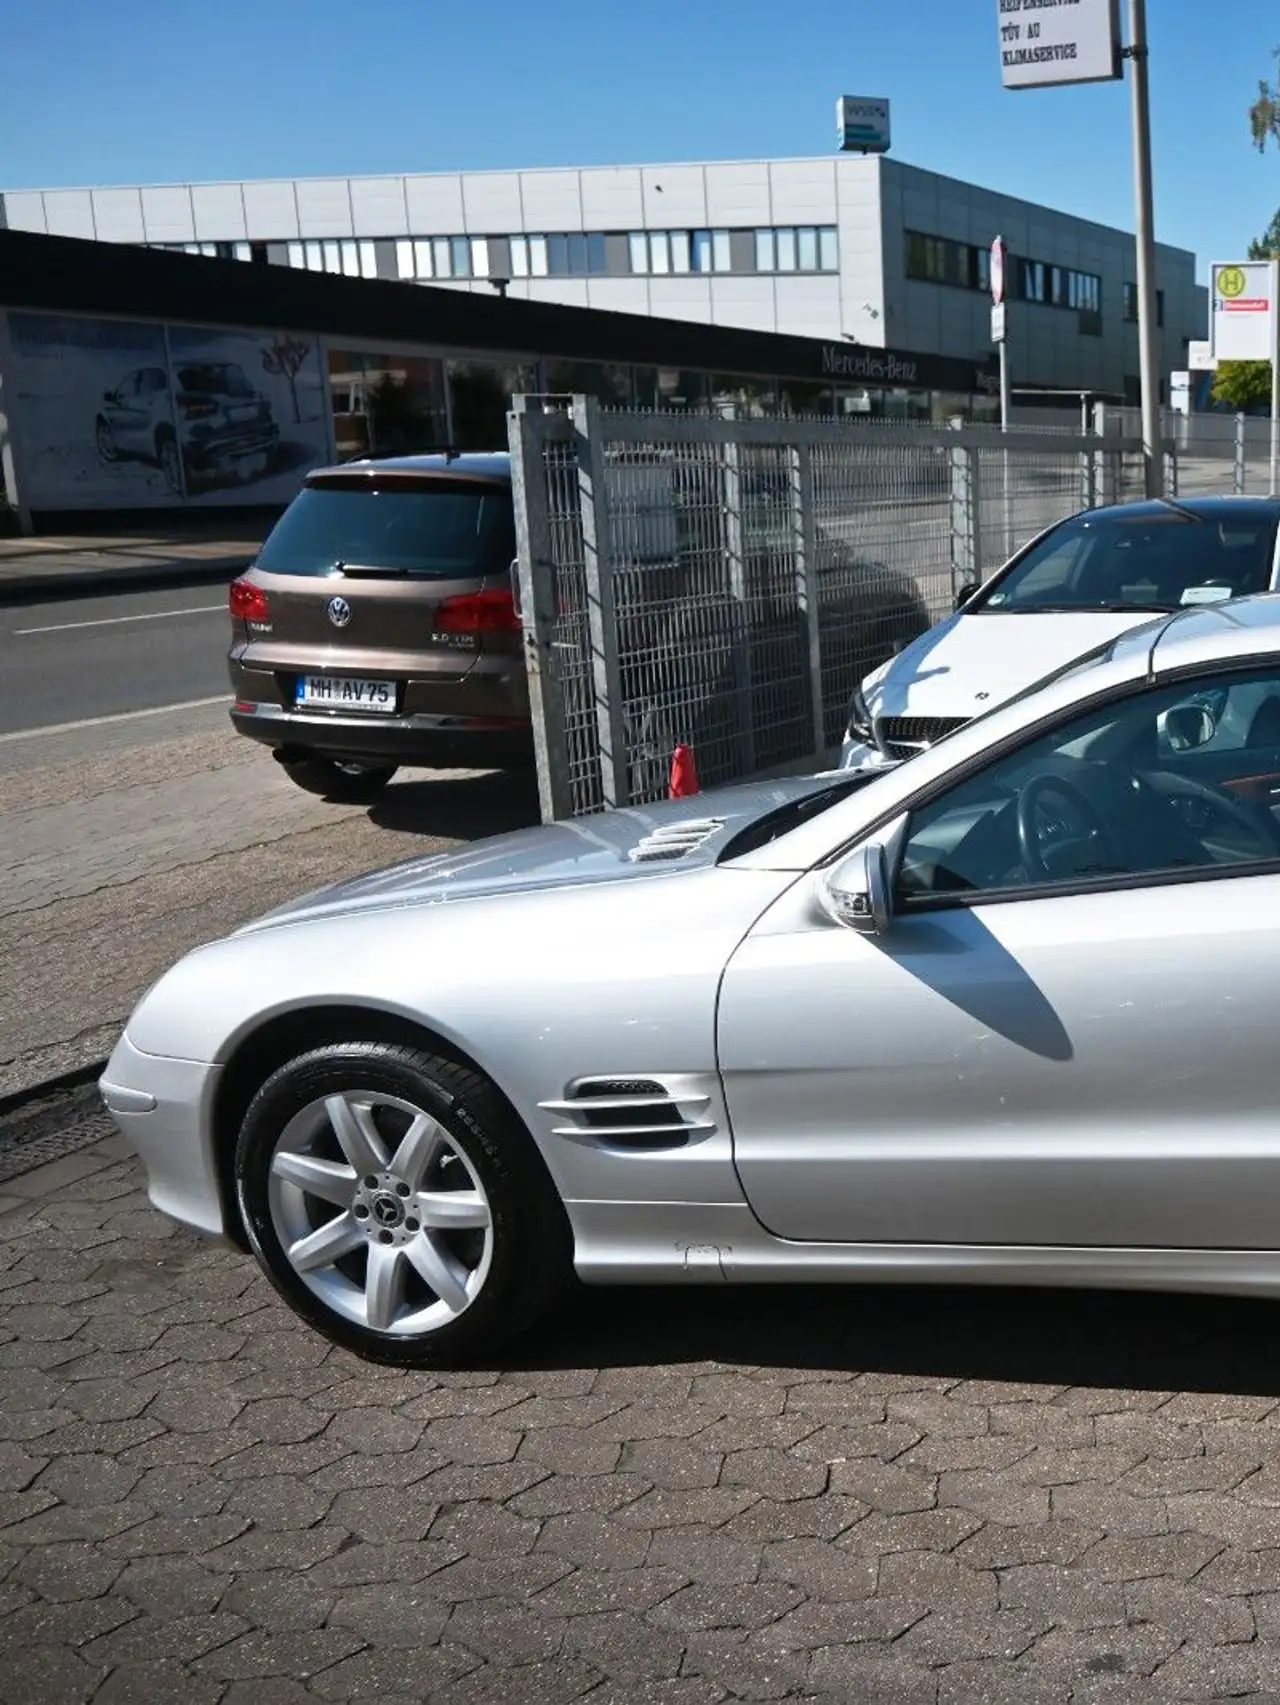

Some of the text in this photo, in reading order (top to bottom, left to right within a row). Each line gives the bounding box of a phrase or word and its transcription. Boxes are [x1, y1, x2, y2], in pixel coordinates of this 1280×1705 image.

[1001, 21, 1041, 42] TÜV AU
[1002, 43, 1077, 66] KLIMASERVICE
[822, 346, 918, 380] Mercedes-Benz
[310, 678, 390, 703] MH AV 75
